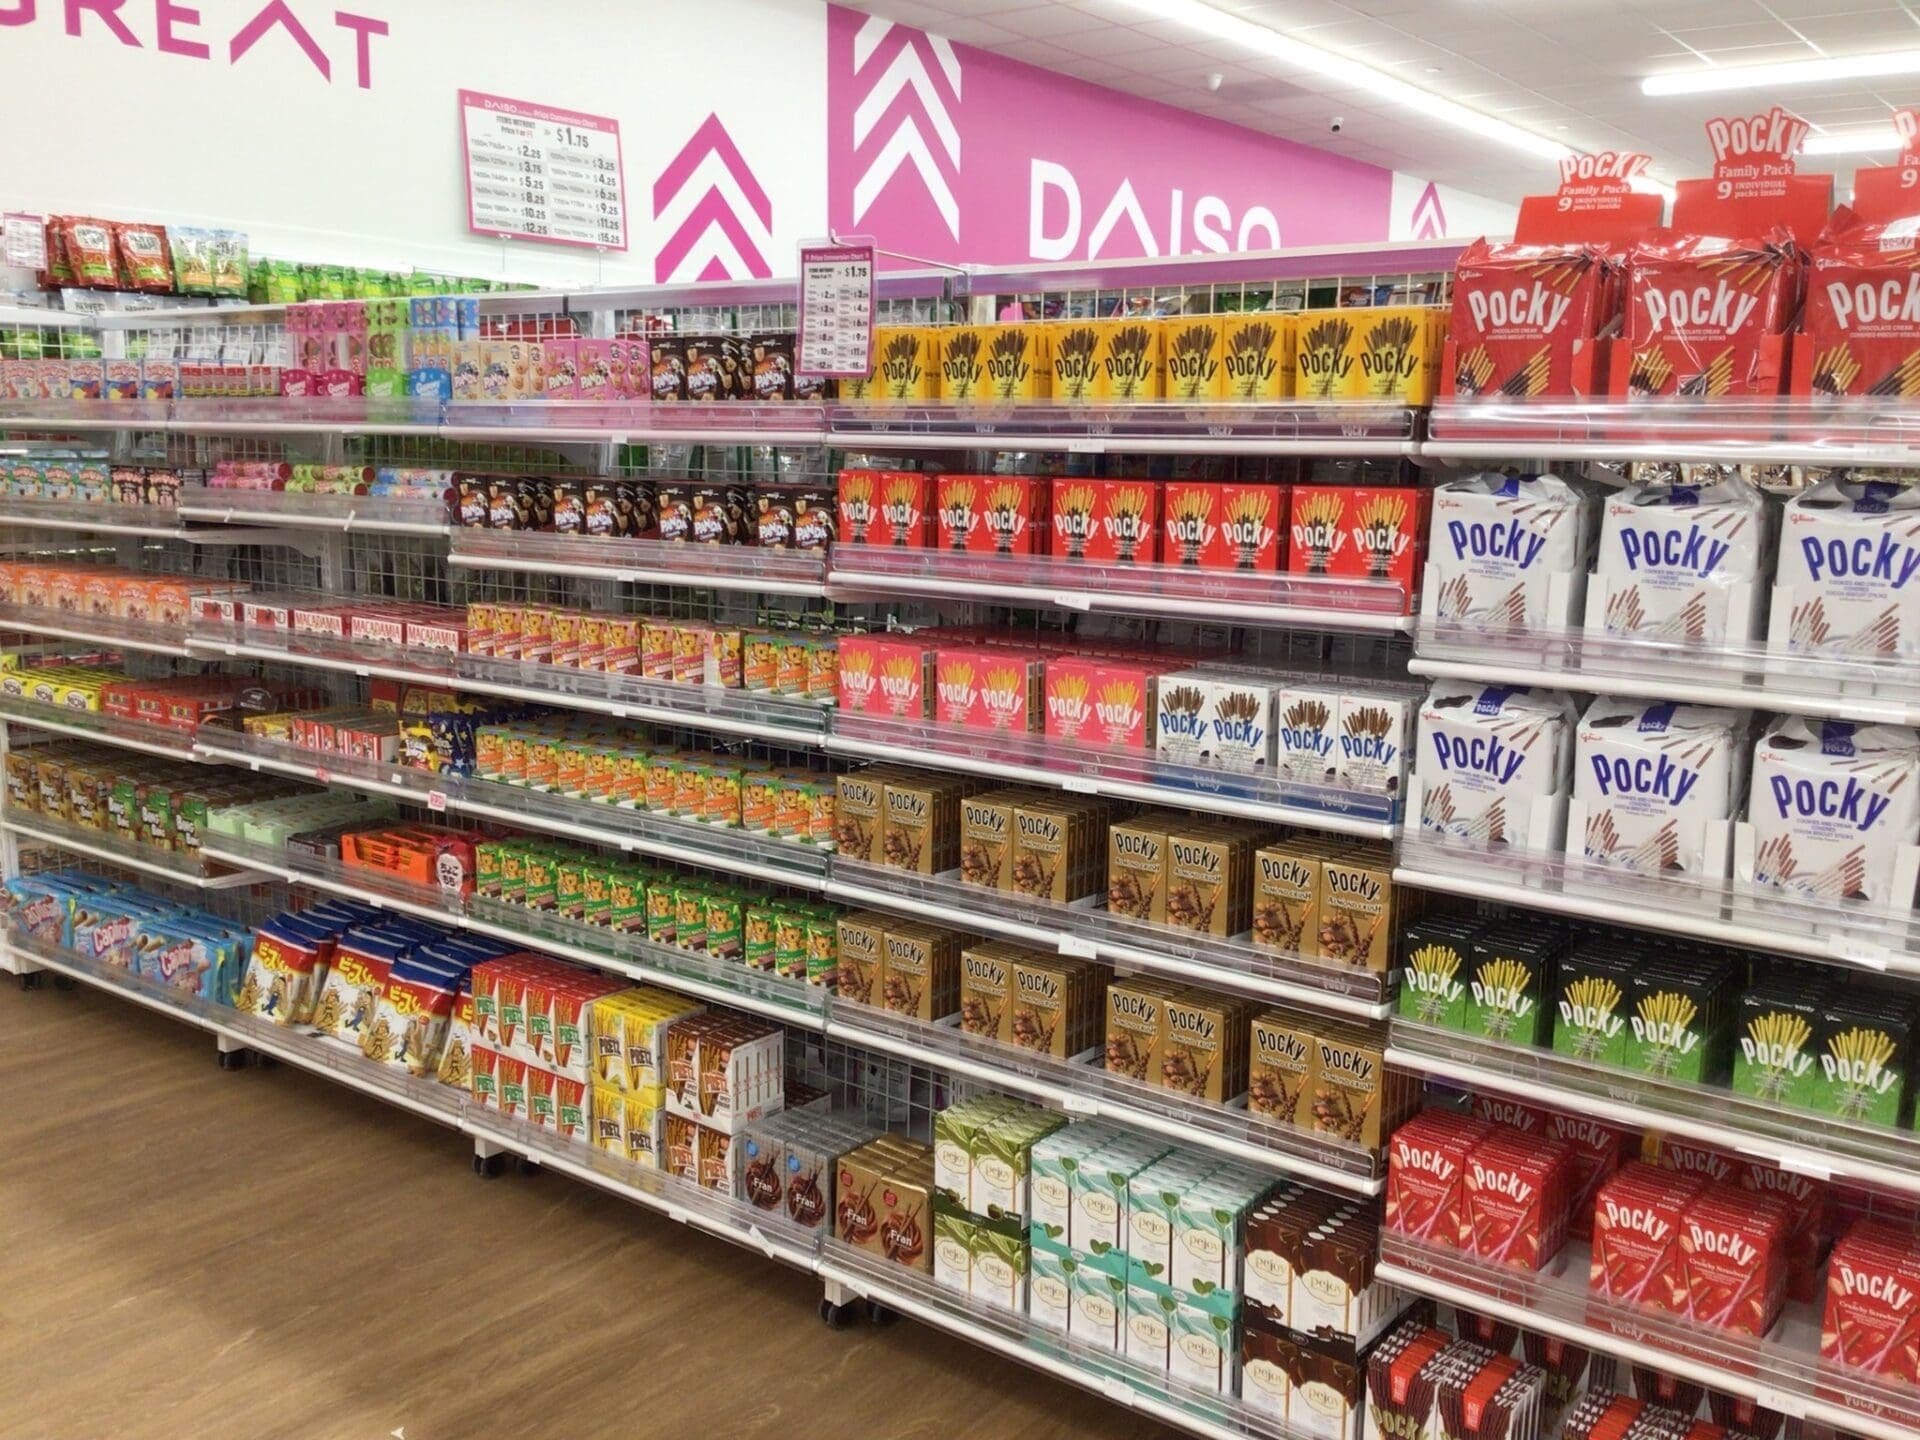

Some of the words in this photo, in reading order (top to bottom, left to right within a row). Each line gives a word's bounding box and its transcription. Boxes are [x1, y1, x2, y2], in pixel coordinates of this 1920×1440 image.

[557, 127, 589, 148] $1.75
[1708, 109, 1809, 161] Pocky
[518, 145, 541, 159] $2.25
[520, 161, 542, 174] $3.75
[592, 158, 616, 172] $3.25
[1720, 166, 1760, 179] Family
[1763, 164, 1792, 176] Pack
[520, 176, 544, 190] $5.25
[594, 174, 616, 186] $4.25
[1735, 180, 1786, 189] INDIVIDUAL
[1901, 170, 1918, 188] 9
[521, 192, 544, 205] $8.25
[595, 189, 618, 202] $6.25
[1562, 183, 1599, 196] Family
[1602, 183, 1629, 194] Pack
[1718, 181, 1732, 200] 9
[1734, 189, 1758, 199] packs
[1760, 188, 1786, 197] inside
[522, 208, 546, 220] $10.25
[596, 202, 618, 216] $9.25
[1558, 197, 1574, 212] 9
[522, 222, 548, 236] $12.25
[597, 218, 620, 230] $11.25
[598, 232, 620, 244] $15.25
[845, 266, 867, 278] $1.75
[1468, 281, 1571, 334] Pocky
[1644, 280, 1758, 335] Pocky
[1448, 519, 1546, 570] Pocky
[1620, 525, 1730, 578] Pocky
[353, 618, 400, 638] MACADAMIA
[408, 625, 456, 646] MACADAMIA
[1432, 732, 1525, 784] Pocky
[1592, 754, 1698, 806] Pocky
[1770, 777, 1890, 831] Pocky
[1404, 966, 1464, 1002] Pocky
[1471, 981, 1534, 1018] Pocky
[1559, 1000, 1624, 1038] Pocky
[1630, 1016, 1700, 1054] Pocky
[600, 1038, 622, 1055] PRETZ
[630, 1048, 654, 1066] PRETZ
[1740, 1037, 1814, 1077] Pocky
[1821, 1054, 1898, 1094] Pocky
[630, 1132, 653, 1150] PRETZ
[1399, 1142, 1455, 1181] Pocky
[754, 1178, 773, 1193] Fran
[1473, 1164, 1533, 1204] Pocky
[796, 1194, 816, 1210] Fran
[846, 1209, 868, 1226] Fran
[1606, 1200, 1670, 1242] Pocky
[1138, 1218, 1168, 1237] pejoy
[890, 1230, 912, 1246] Fran
[1190, 1236, 1219, 1256] pejoy
[1689, 1224, 1758, 1266] Pocky
[1255, 1254, 1286, 1274] pejoy
[1310, 1276, 1344, 1295] pejoy
[1840, 1266, 1914, 1310] Pocky
[1308, 1386, 1340, 1406] pejoy
